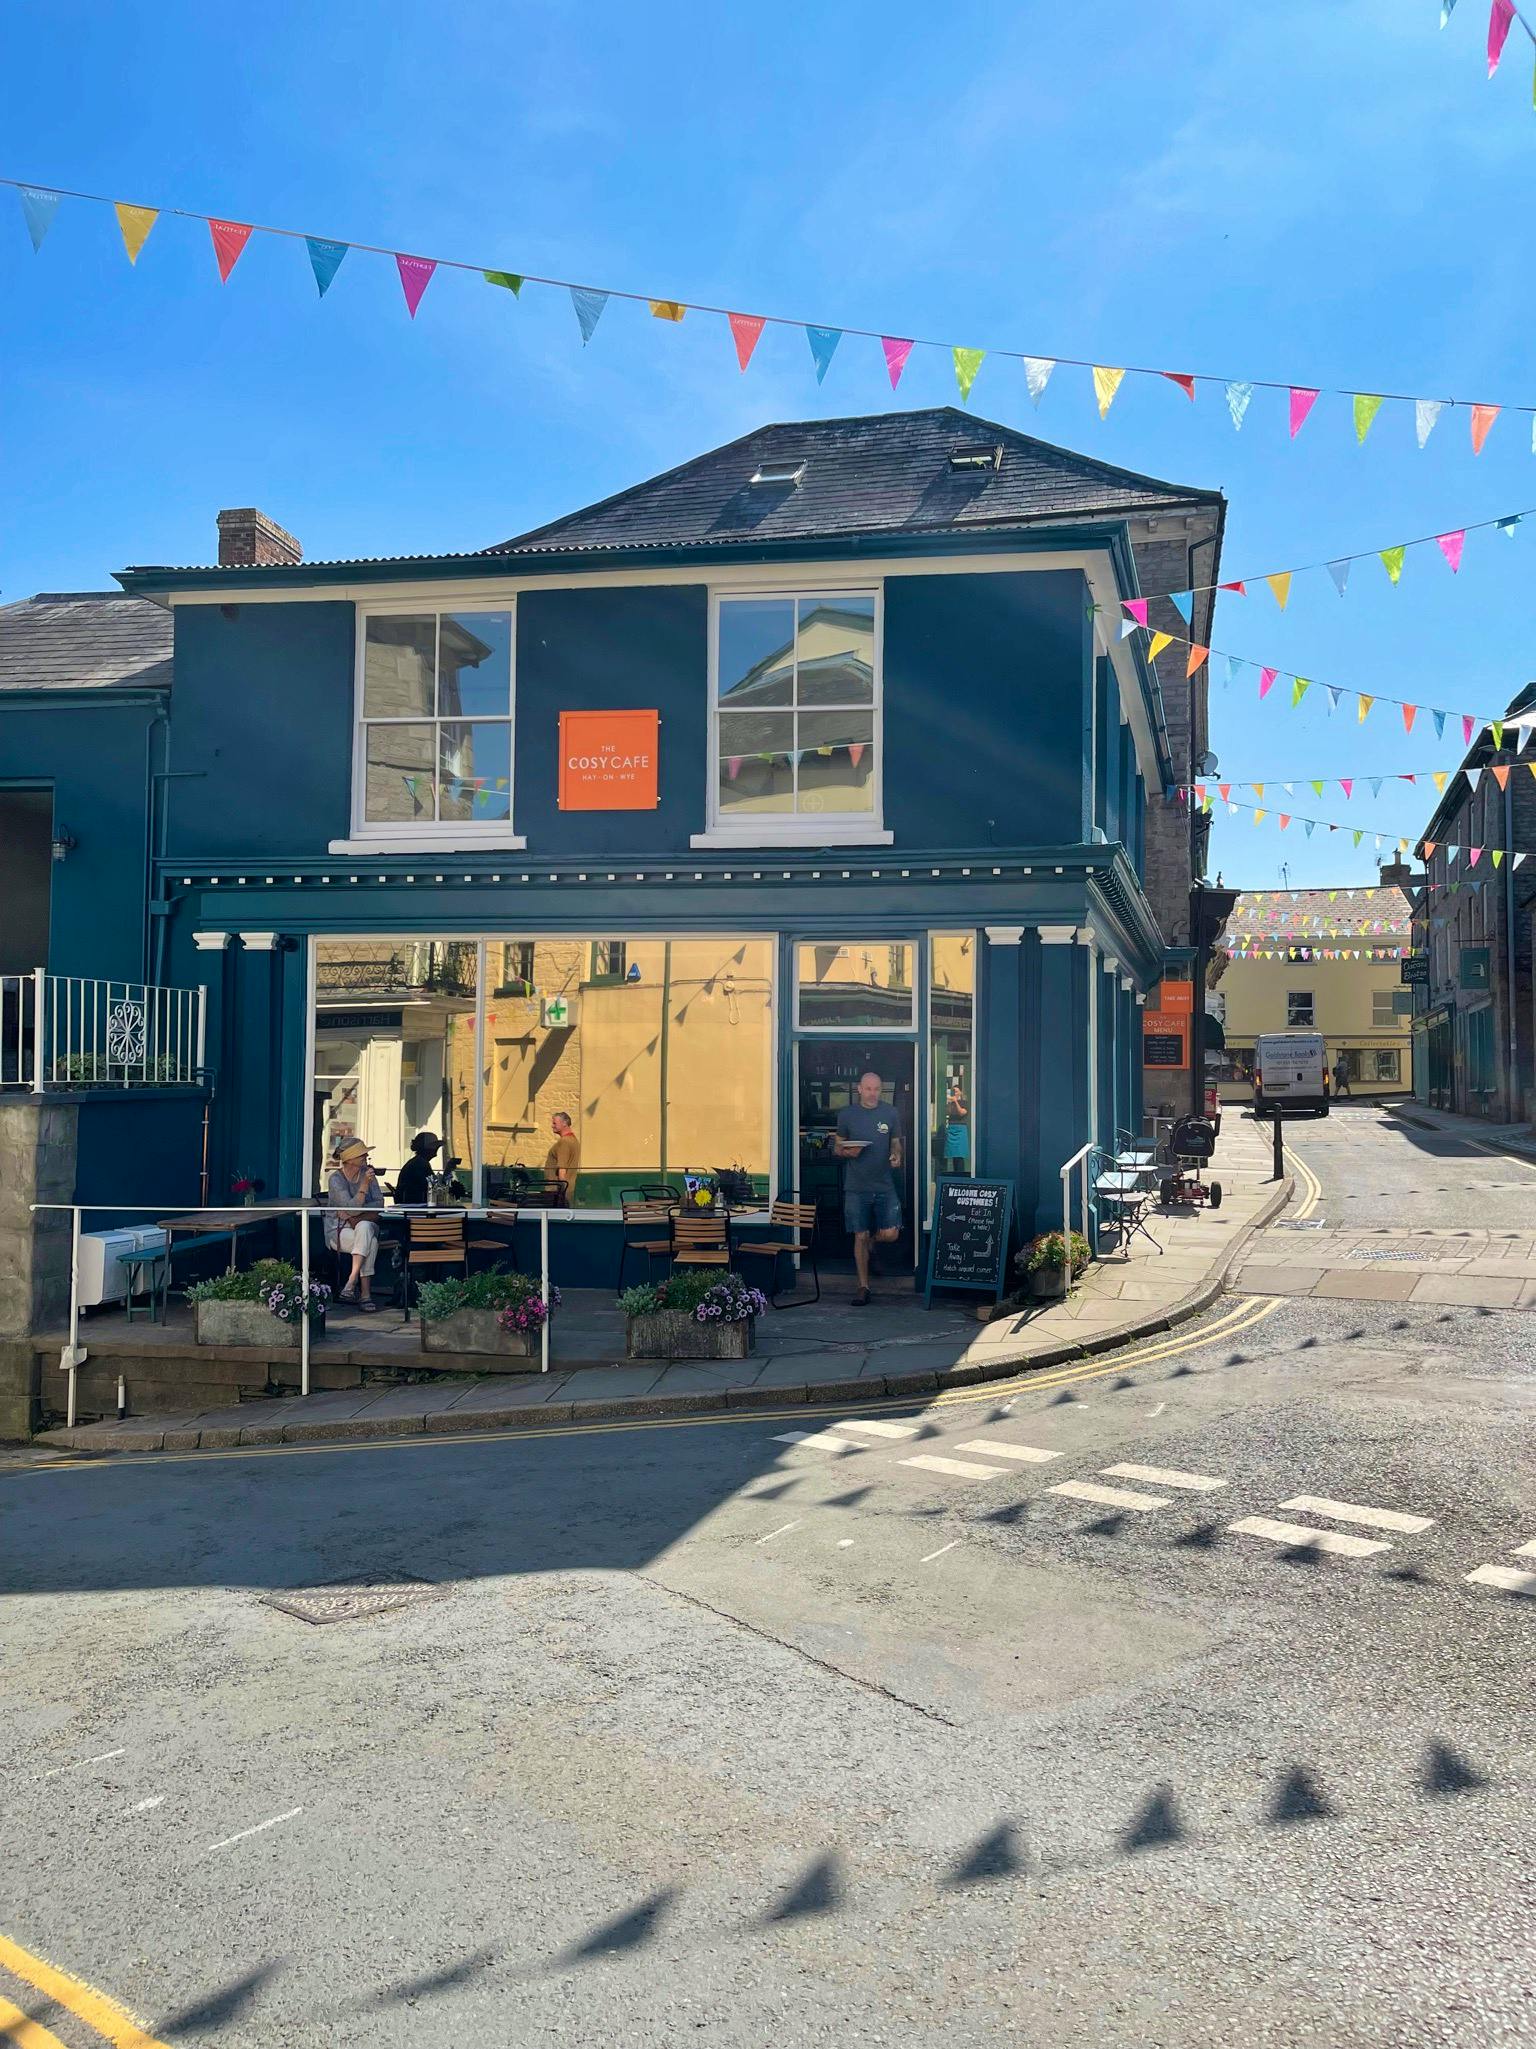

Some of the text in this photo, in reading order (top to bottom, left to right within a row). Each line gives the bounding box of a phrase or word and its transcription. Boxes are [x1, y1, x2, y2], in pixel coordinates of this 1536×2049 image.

[568, 755, 649, 769] COSY CAFE
[1143, 1019, 1163, 1027] COSY
[949, 1188, 998, 1198] WELCOME COSY
[971, 1208, 992, 1217] Eat In
[947, 1243, 961, 1252] Take
[943, 1263, 957, 1272] Hatch
[958, 1264, 975, 1273] around
